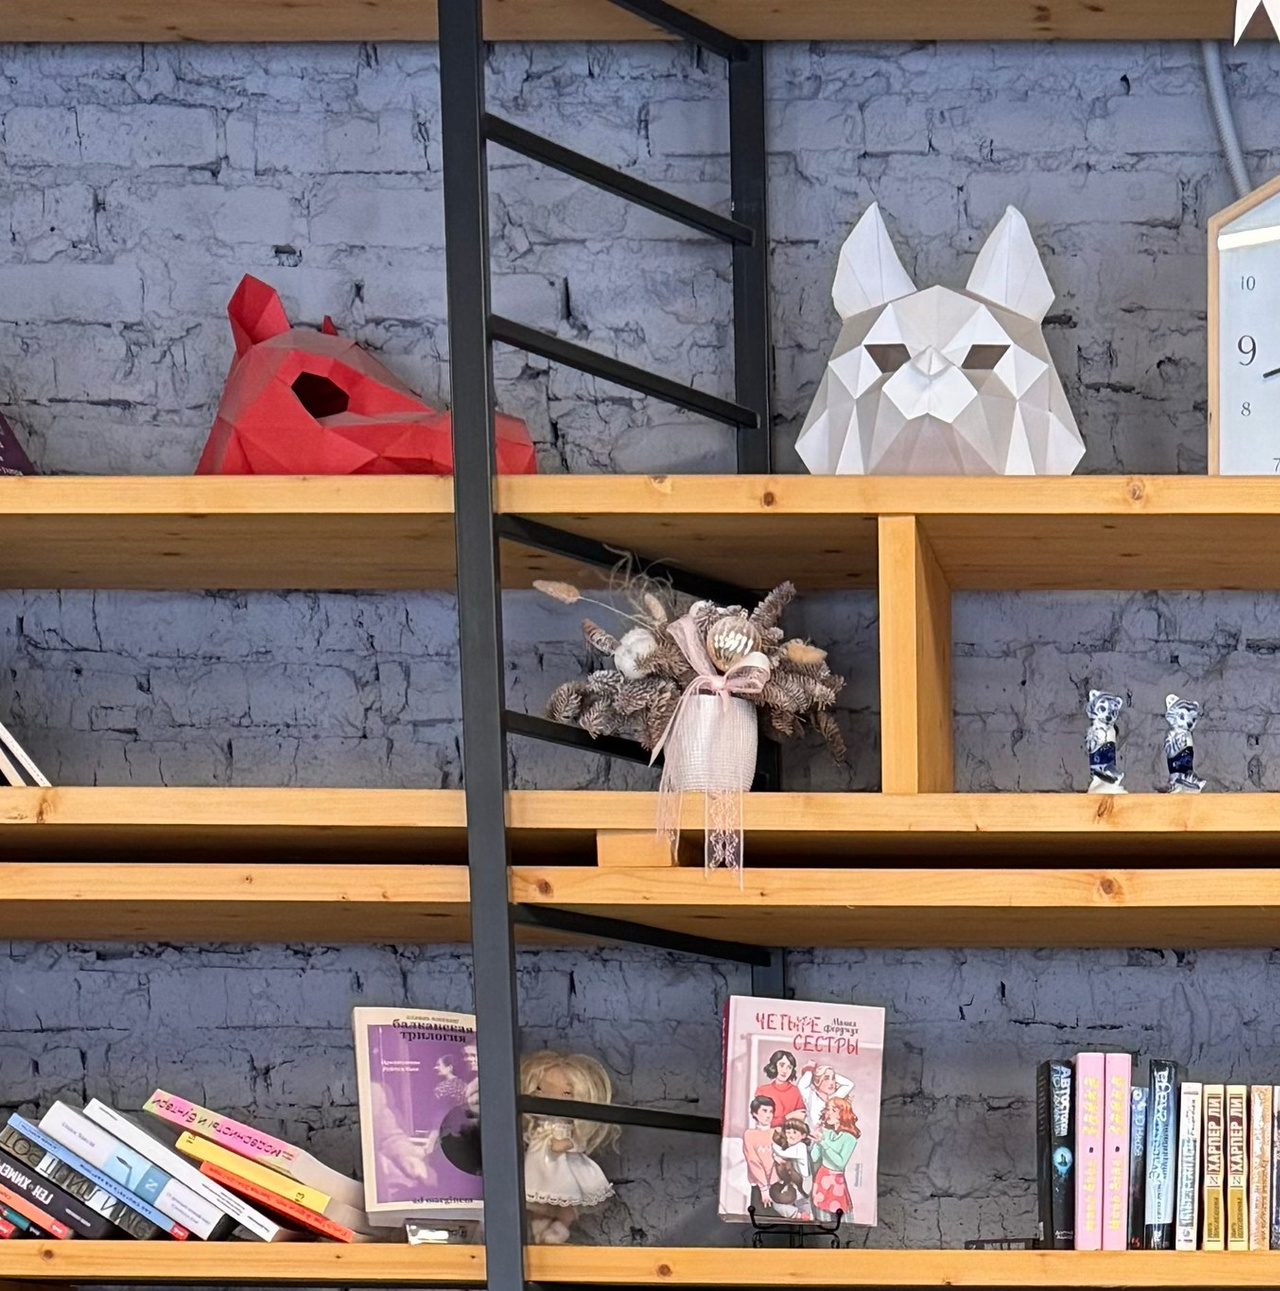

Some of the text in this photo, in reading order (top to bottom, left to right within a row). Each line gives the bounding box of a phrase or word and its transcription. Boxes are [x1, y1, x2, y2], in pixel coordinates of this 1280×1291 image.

[1240, 276, 1256, 291] 10
[1237, 335, 1257, 366] 9
[1240, 402, 1251, 417] 8
[755, 1012, 822, 1034] ЧЕТЫРЕ
[793, 1034, 860, 1055] СЕСТРЫ
[1208, 1096, 1222, 1171] ХАРПЕР ЛИ
[1230, 1096, 1244, 1171] ХАРПЕР ЛИ
